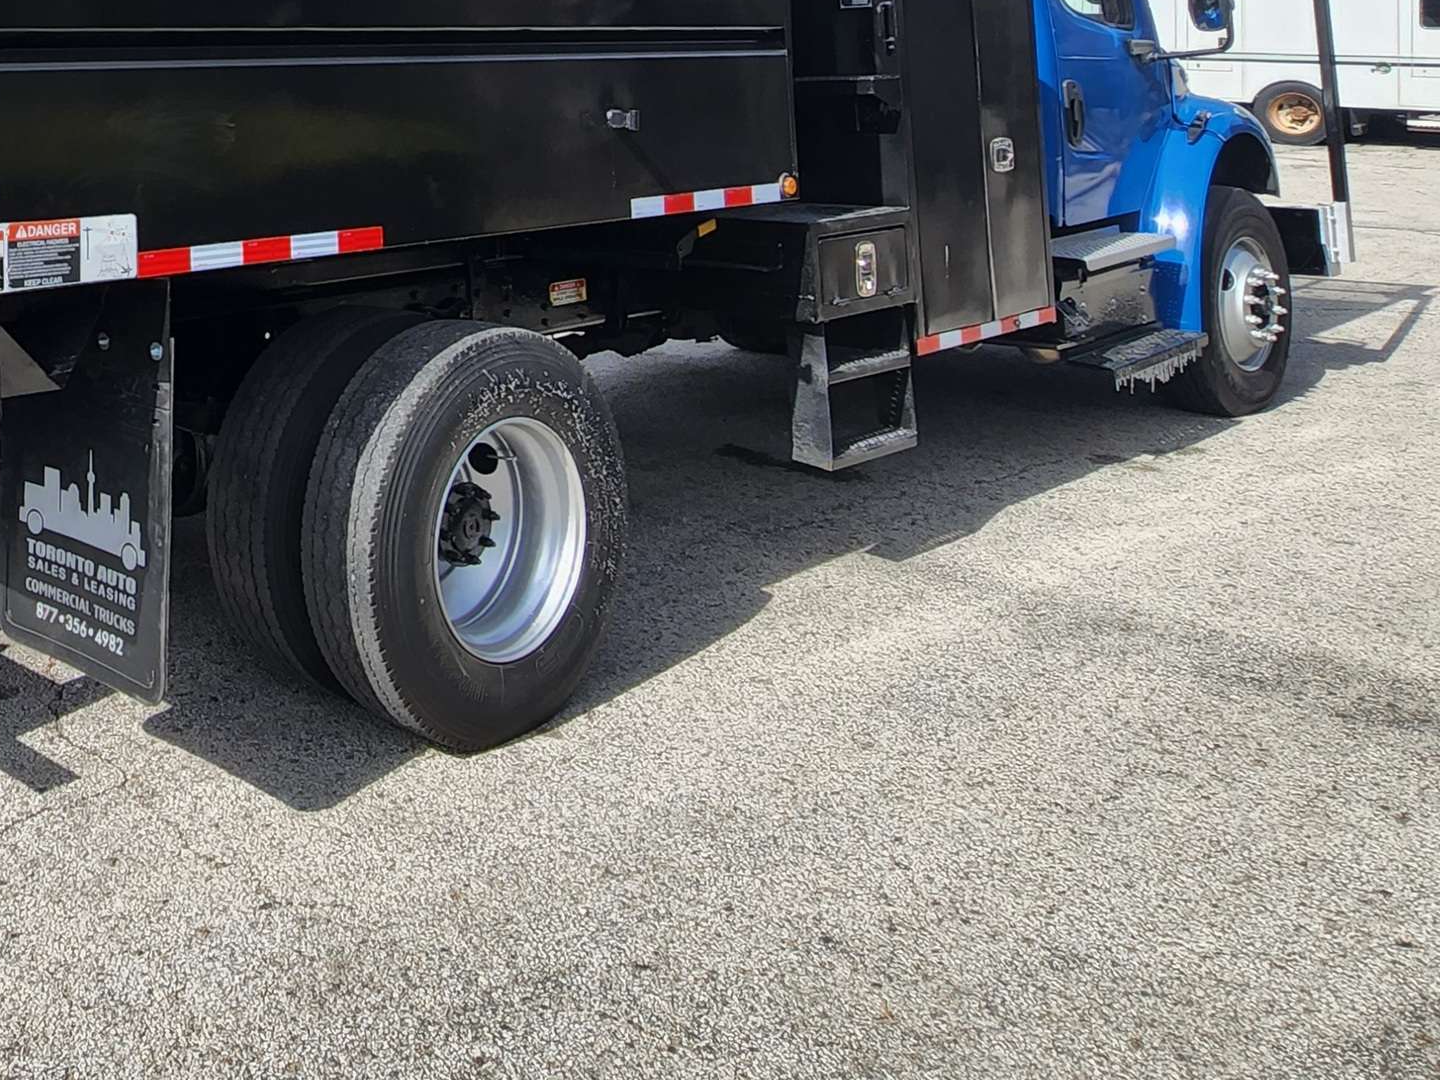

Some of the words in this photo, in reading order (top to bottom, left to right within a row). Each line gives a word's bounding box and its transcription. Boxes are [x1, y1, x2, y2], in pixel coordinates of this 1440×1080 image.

[28, 223, 76, 237] DANGER
[26, 538, 94, 576] TORONTO
[97, 564, 136, 596] AUTO
[27, 555, 66, 581] SALES
[72, 575, 78, 586] &
[84, 579, 135, 610] LEASING
[26, 577, 91, 616] COMMERCIAL
[94, 604, 135, 635] TRUCKS
